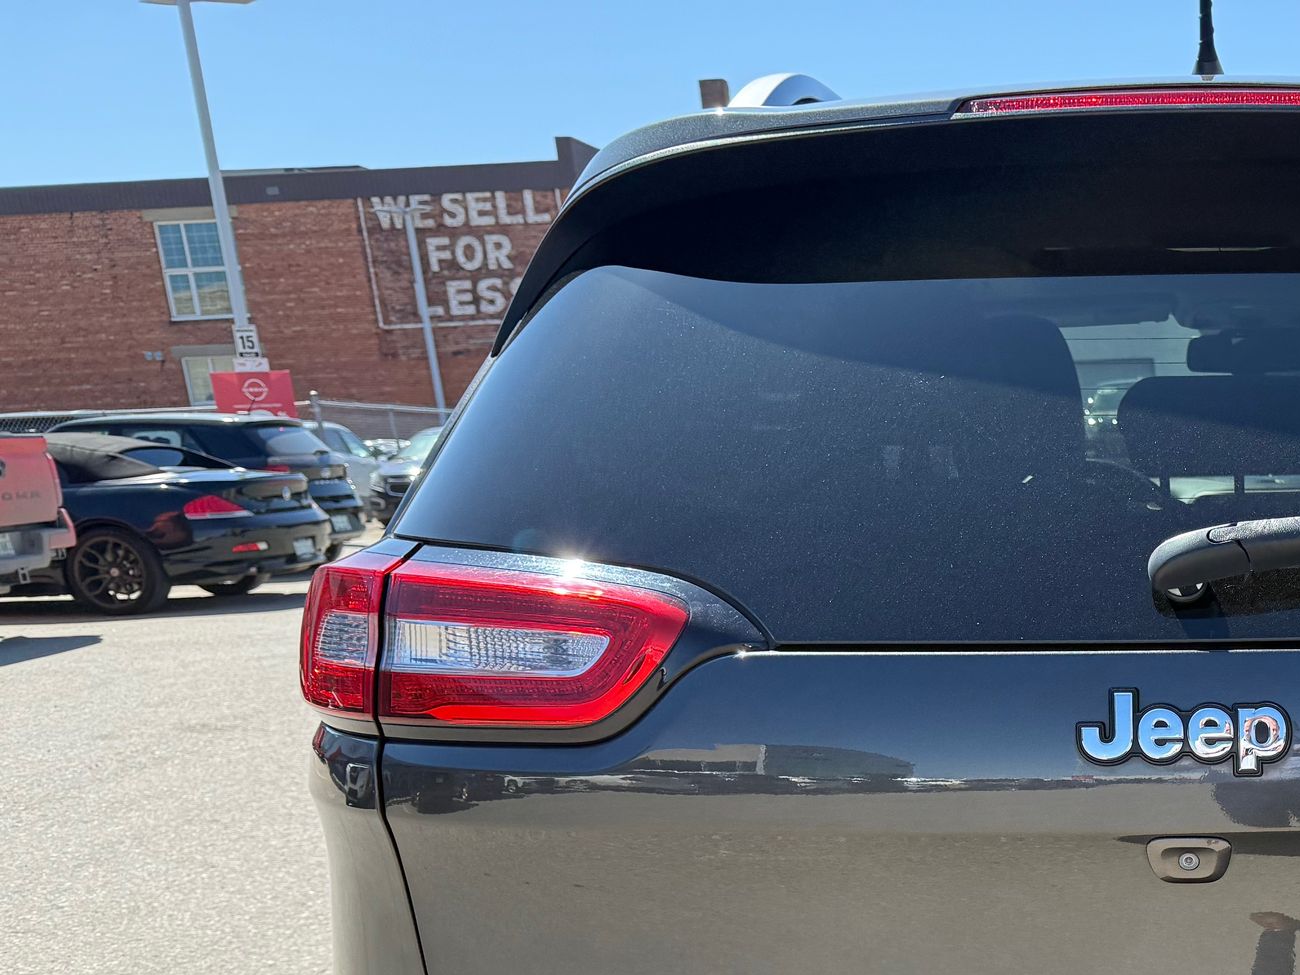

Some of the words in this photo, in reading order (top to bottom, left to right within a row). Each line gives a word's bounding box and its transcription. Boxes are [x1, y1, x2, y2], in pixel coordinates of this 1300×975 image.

[370, 193, 436, 230] WE
[440, 189, 551, 228] SELL
[425, 234, 514, 273] FOR
[239, 335, 255, 350] 15
[1078, 688, 1291, 776] Jeep
